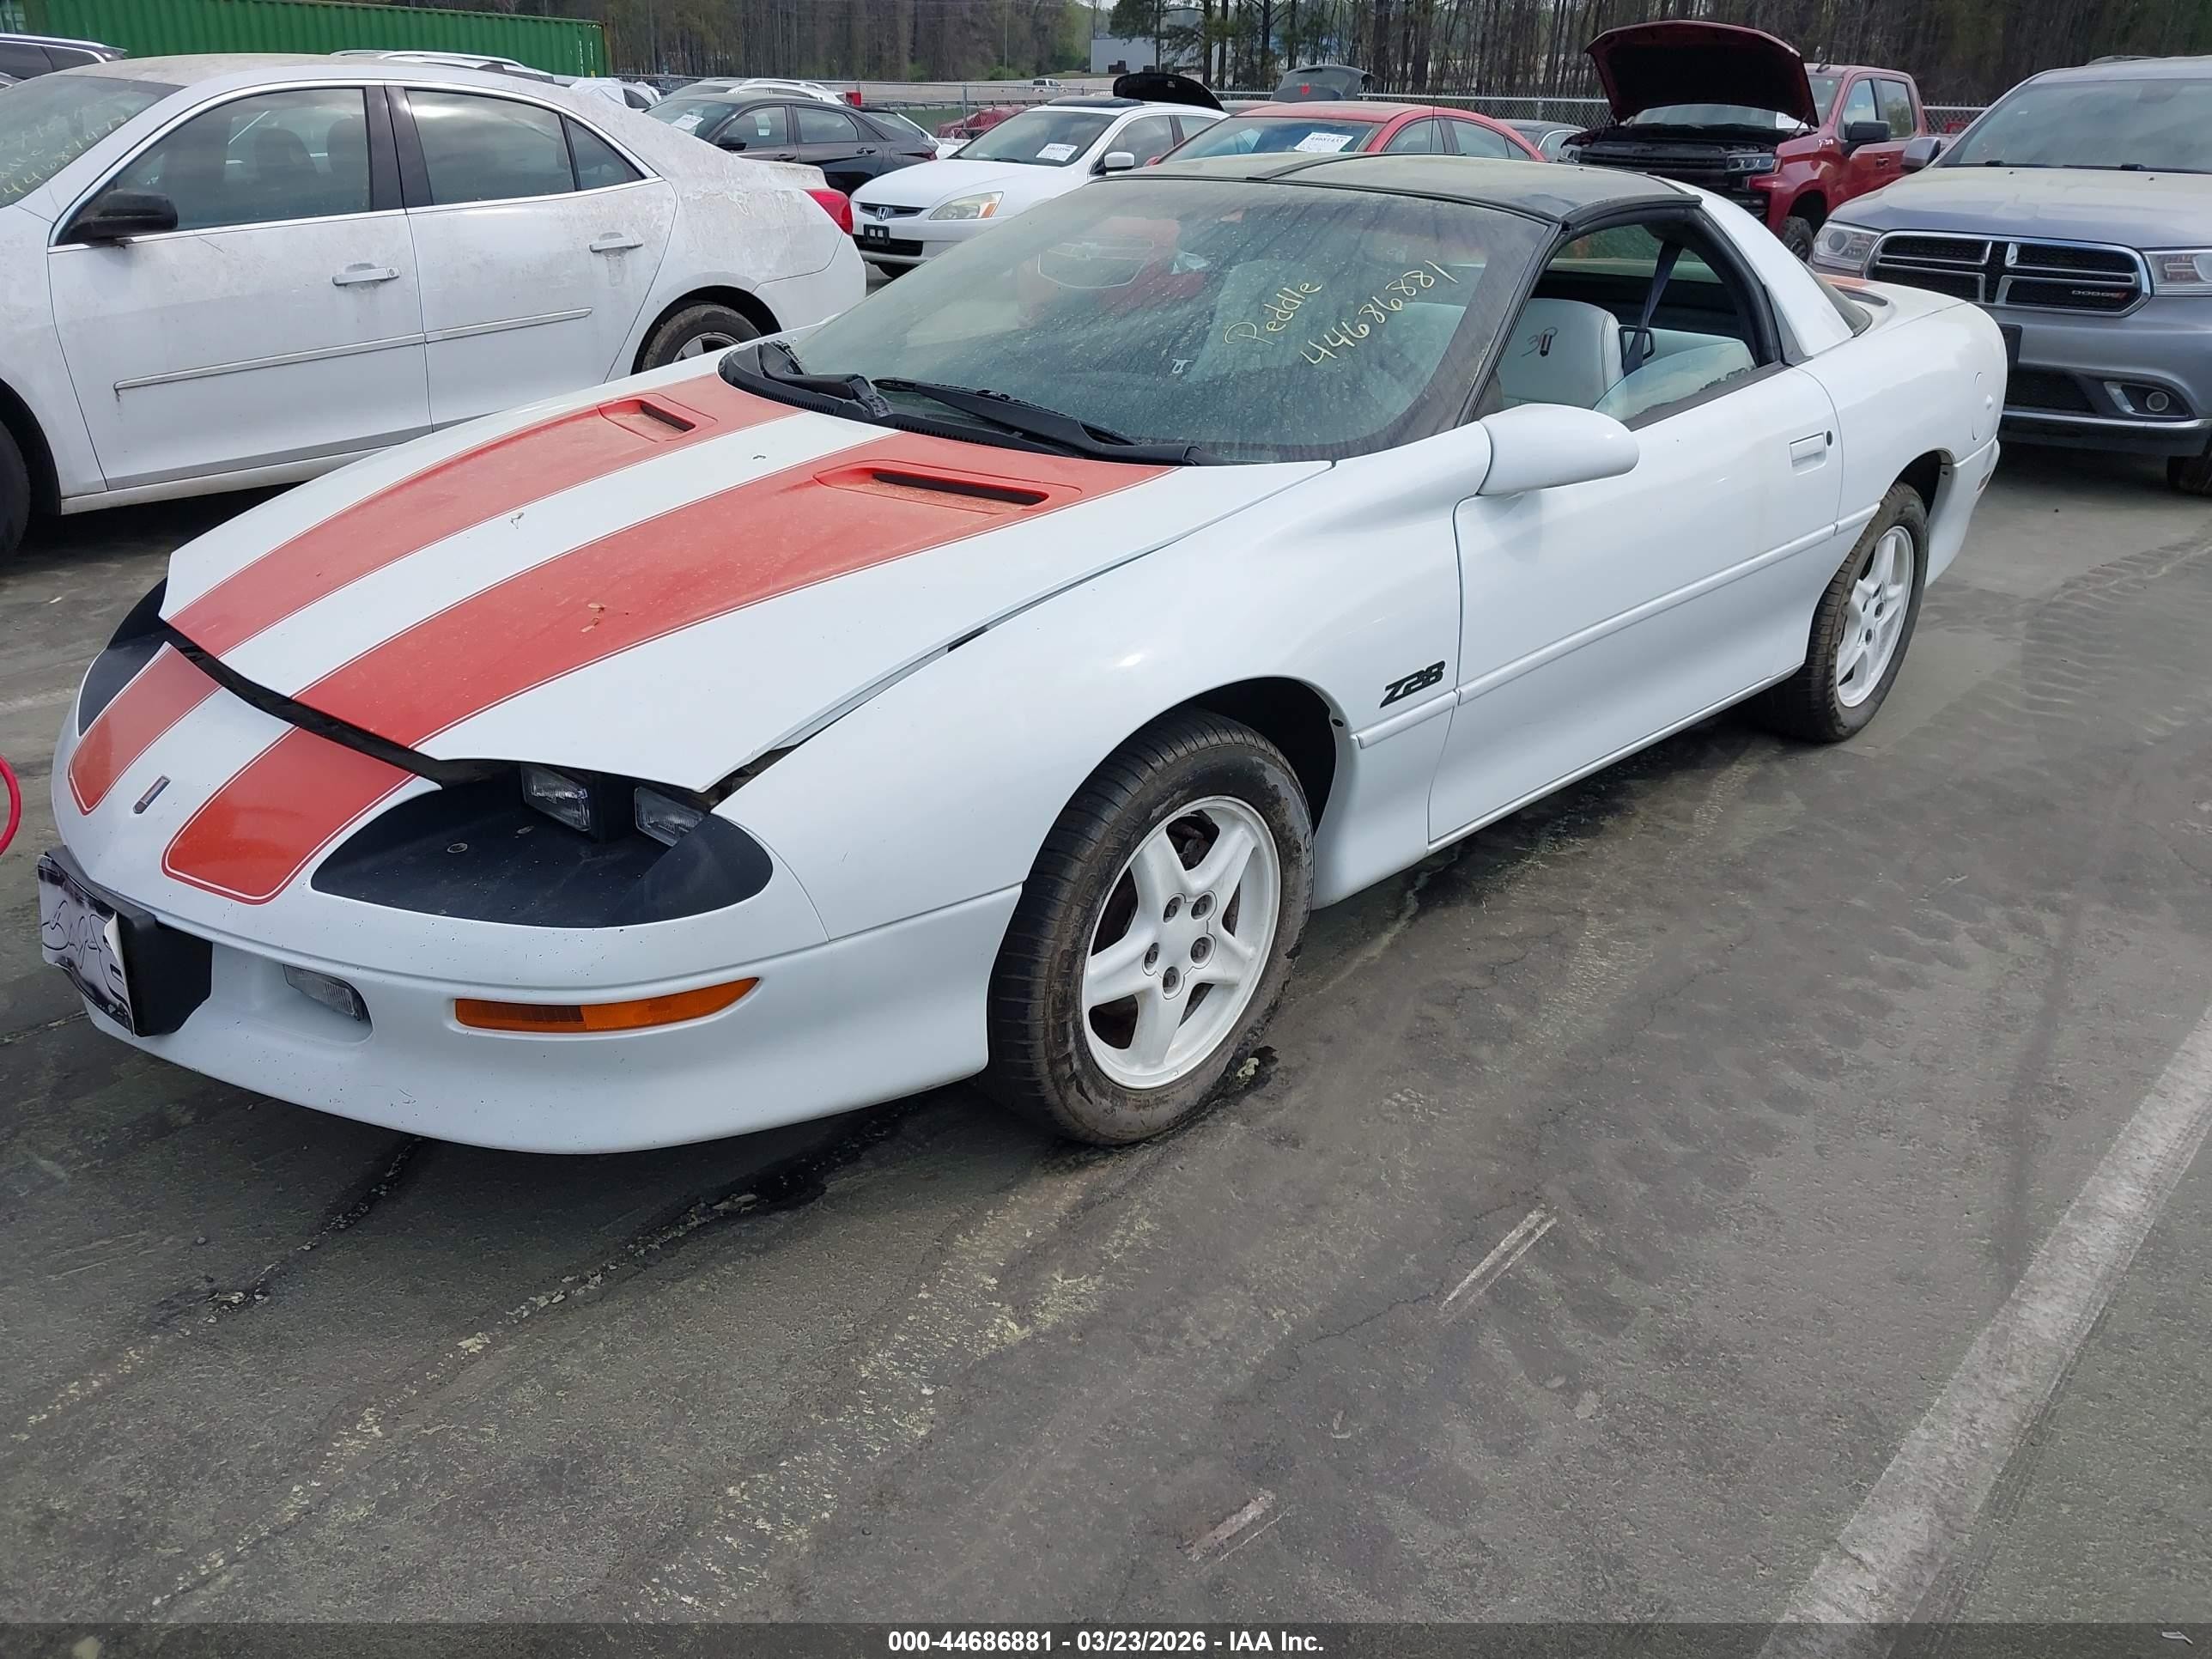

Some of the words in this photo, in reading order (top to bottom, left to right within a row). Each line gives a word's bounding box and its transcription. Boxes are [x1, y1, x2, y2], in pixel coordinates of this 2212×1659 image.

[1224, 282, 1322, 345] Peddle
[1300, 259, 1459, 365] 44686881
[1379, 660, 1446, 708] Z28
